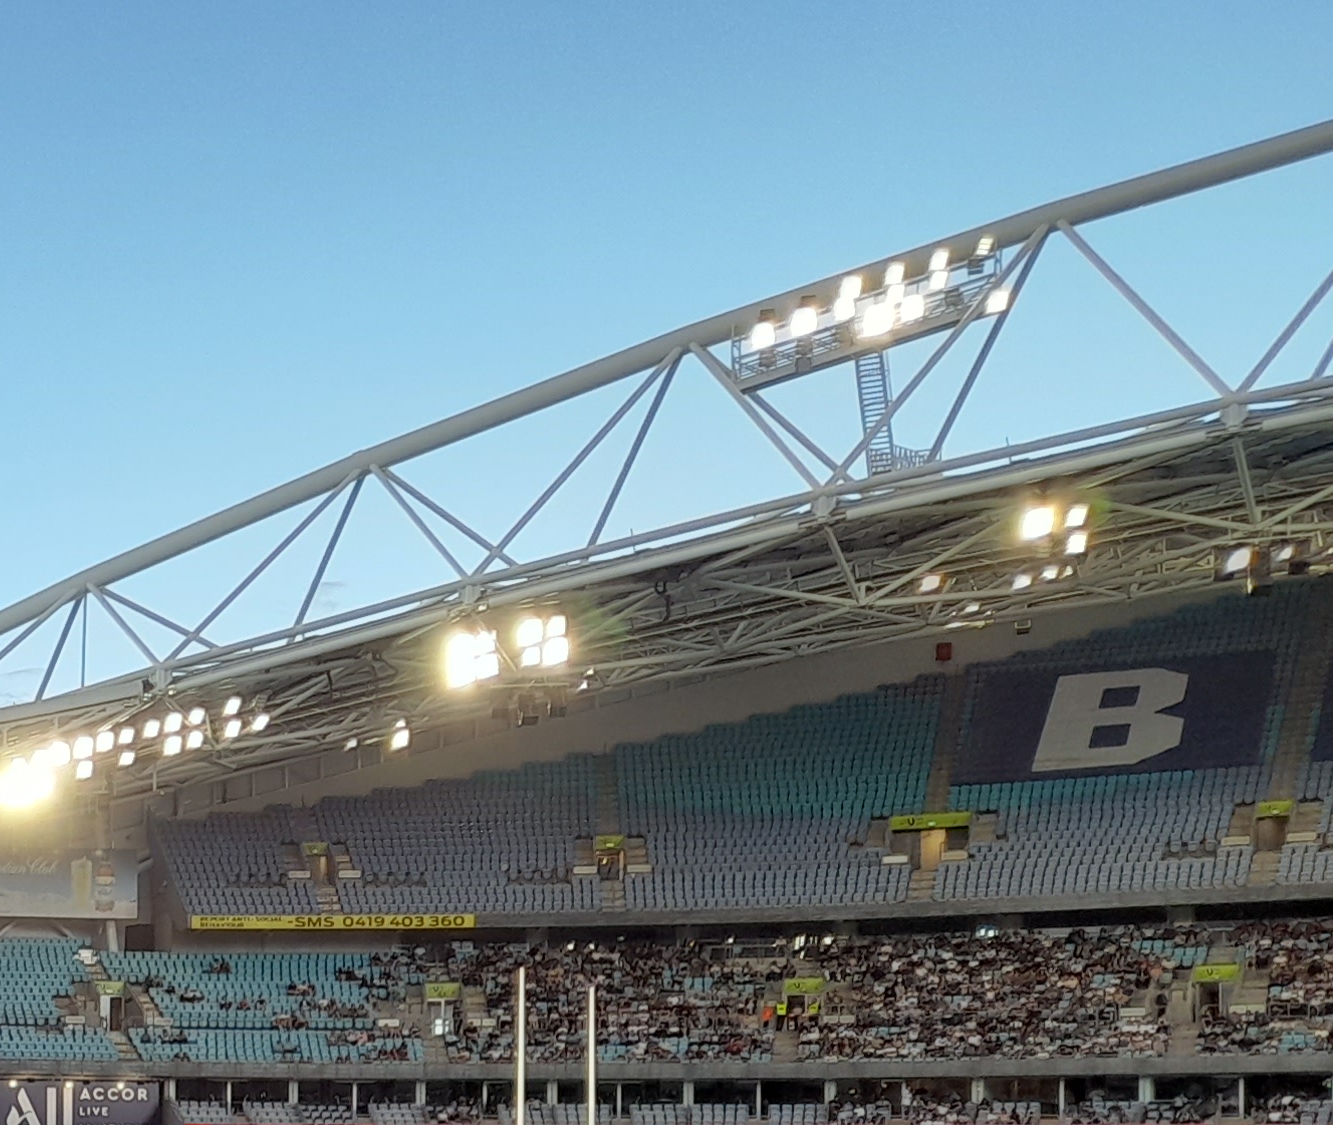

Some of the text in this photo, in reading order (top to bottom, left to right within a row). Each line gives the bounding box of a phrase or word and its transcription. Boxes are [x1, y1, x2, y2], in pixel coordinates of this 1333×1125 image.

[1032, 667, 1189, 772] B
[342, 915, 385, 928] 0419
[389, 916, 425, 928] 403
[428, 915, 465, 928] 360
[79, 1087, 149, 1101] ACCOR
[79, 1106, 109, 1117] LIVE
